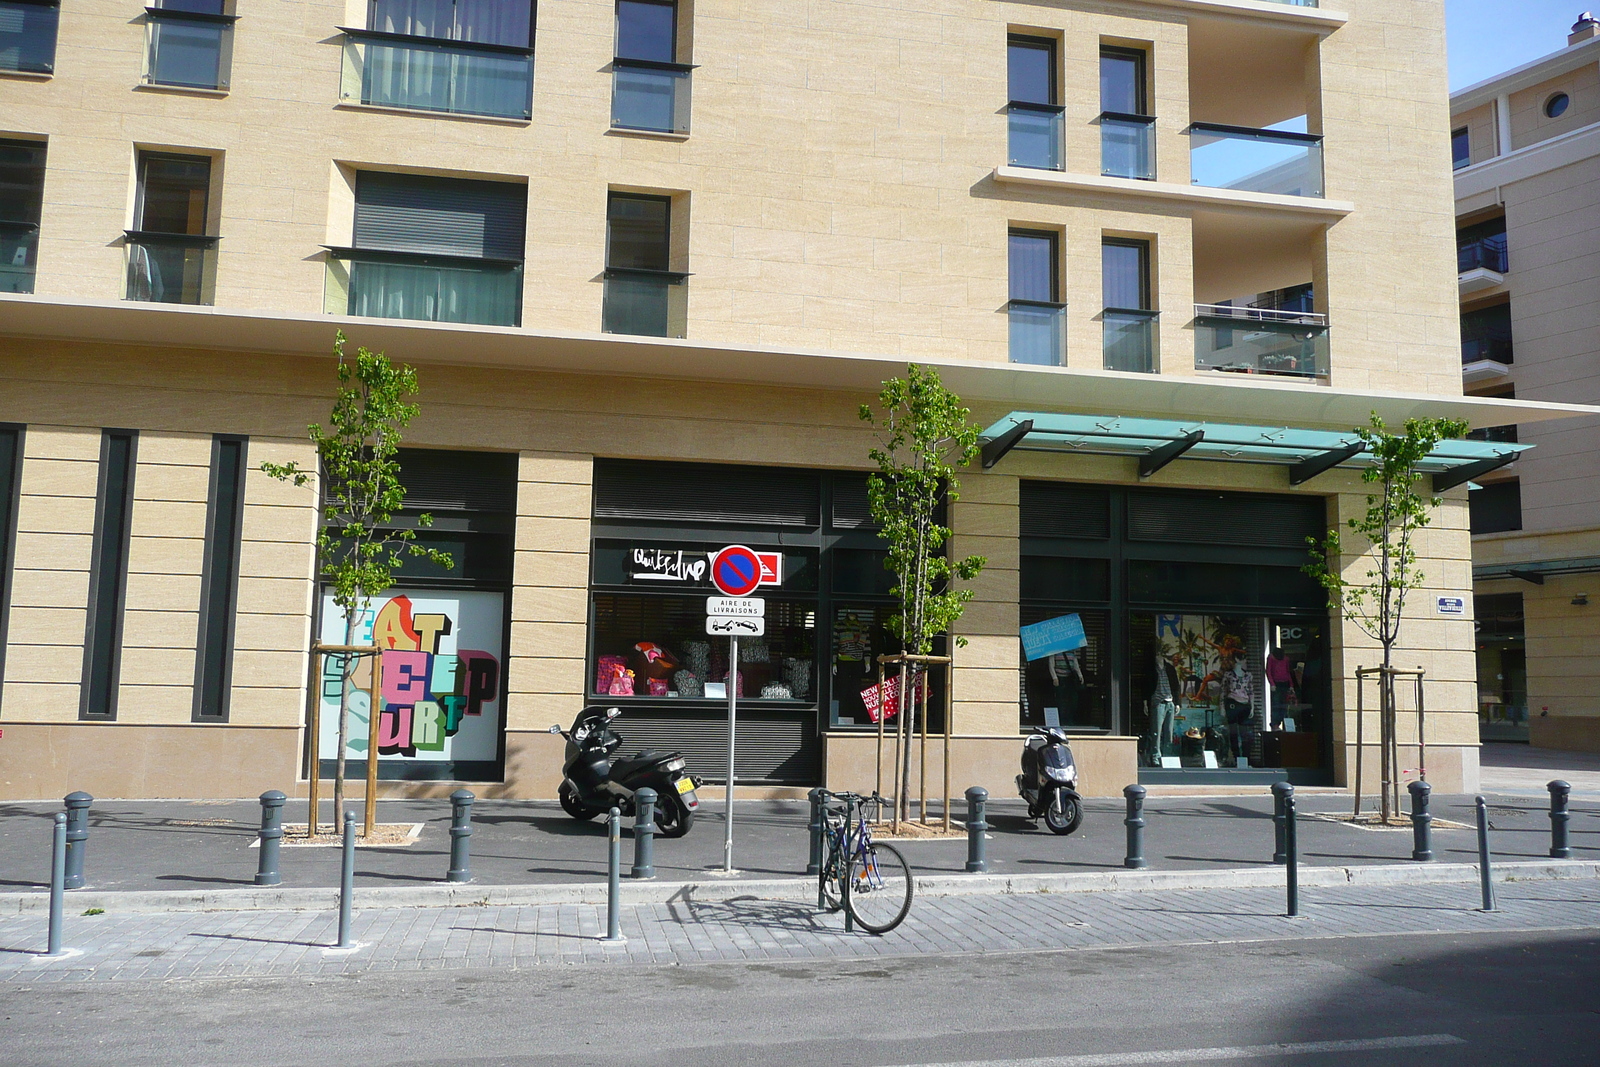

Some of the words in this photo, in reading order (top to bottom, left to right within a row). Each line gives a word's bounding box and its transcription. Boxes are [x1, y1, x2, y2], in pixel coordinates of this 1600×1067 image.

[344, 594, 452, 655] EAT
[860, 686, 878, 698] NEW
[338, 689, 467, 757] SURF
